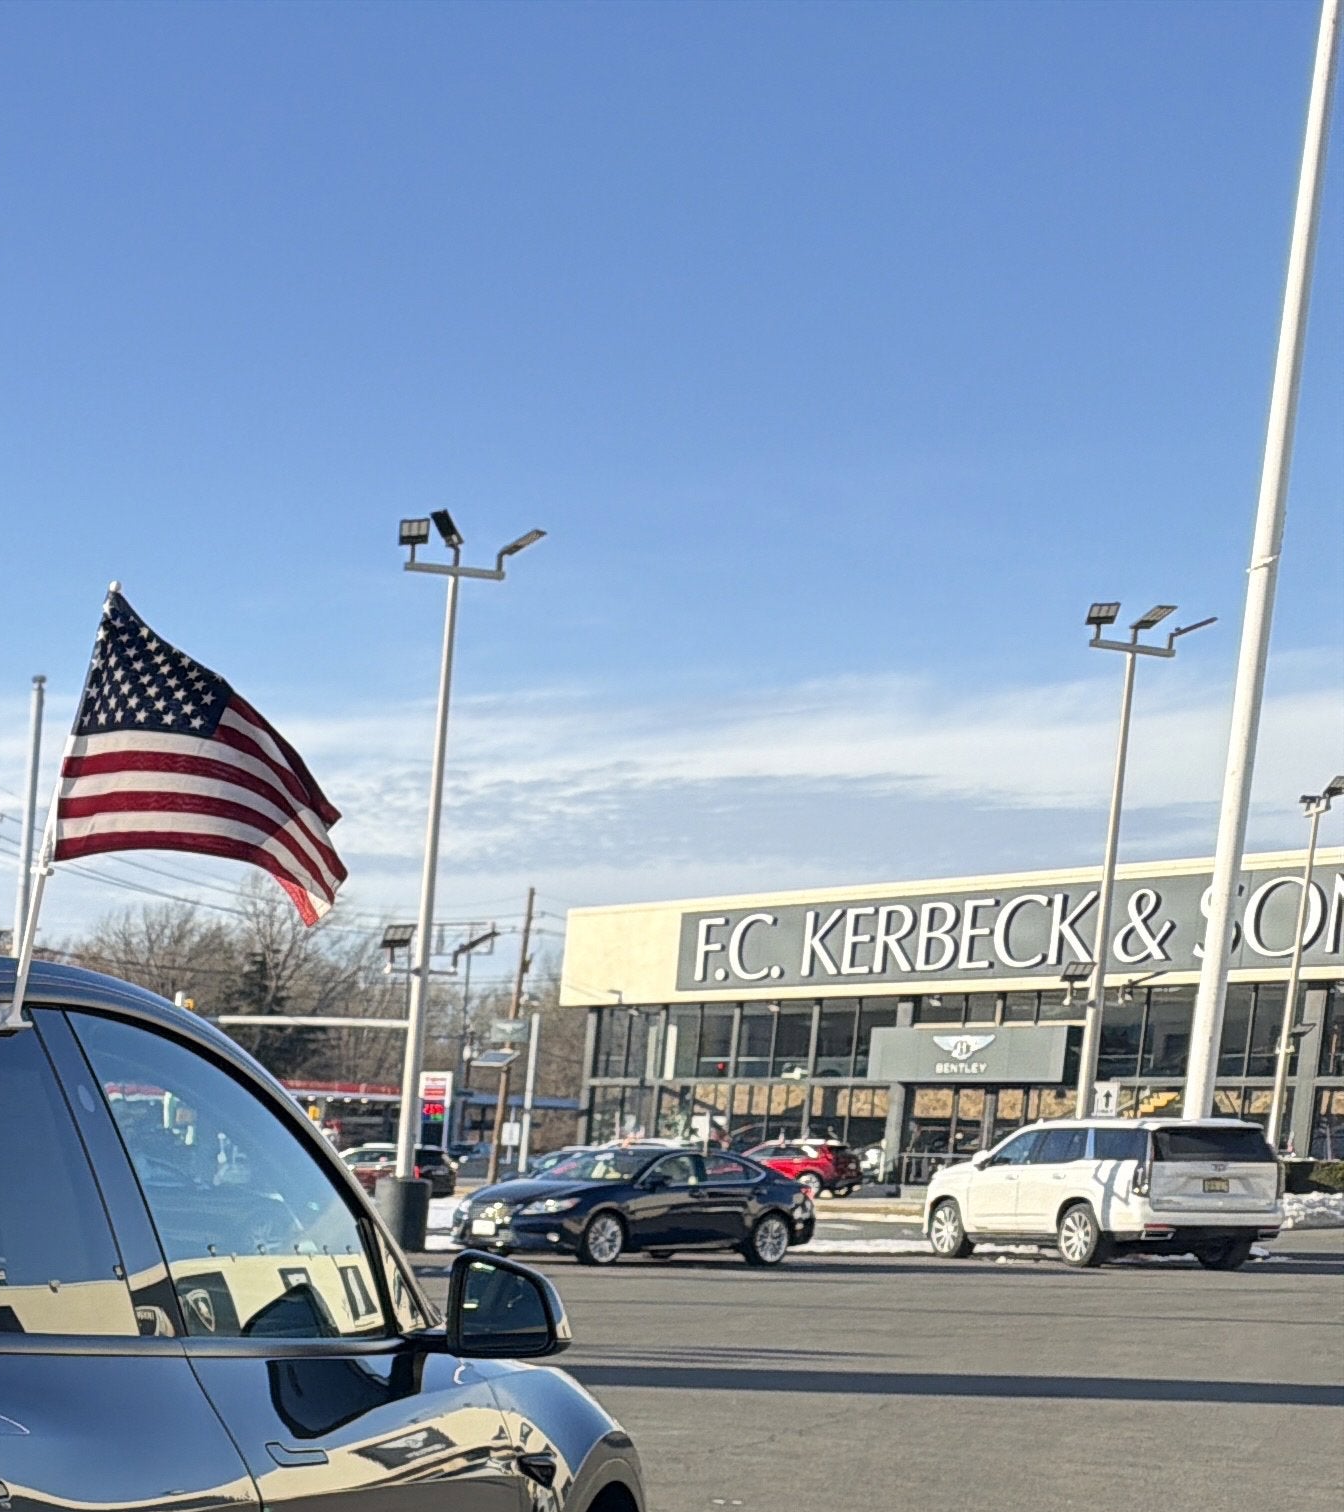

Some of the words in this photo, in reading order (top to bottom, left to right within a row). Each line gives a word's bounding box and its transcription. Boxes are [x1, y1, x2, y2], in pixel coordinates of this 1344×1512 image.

[693, 913, 785, 982] F.C.
[800, 890, 1099, 978] KERBECK
[1113, 888, 1177, 964] &
[935, 1062, 988, 1075] BENTLEY
